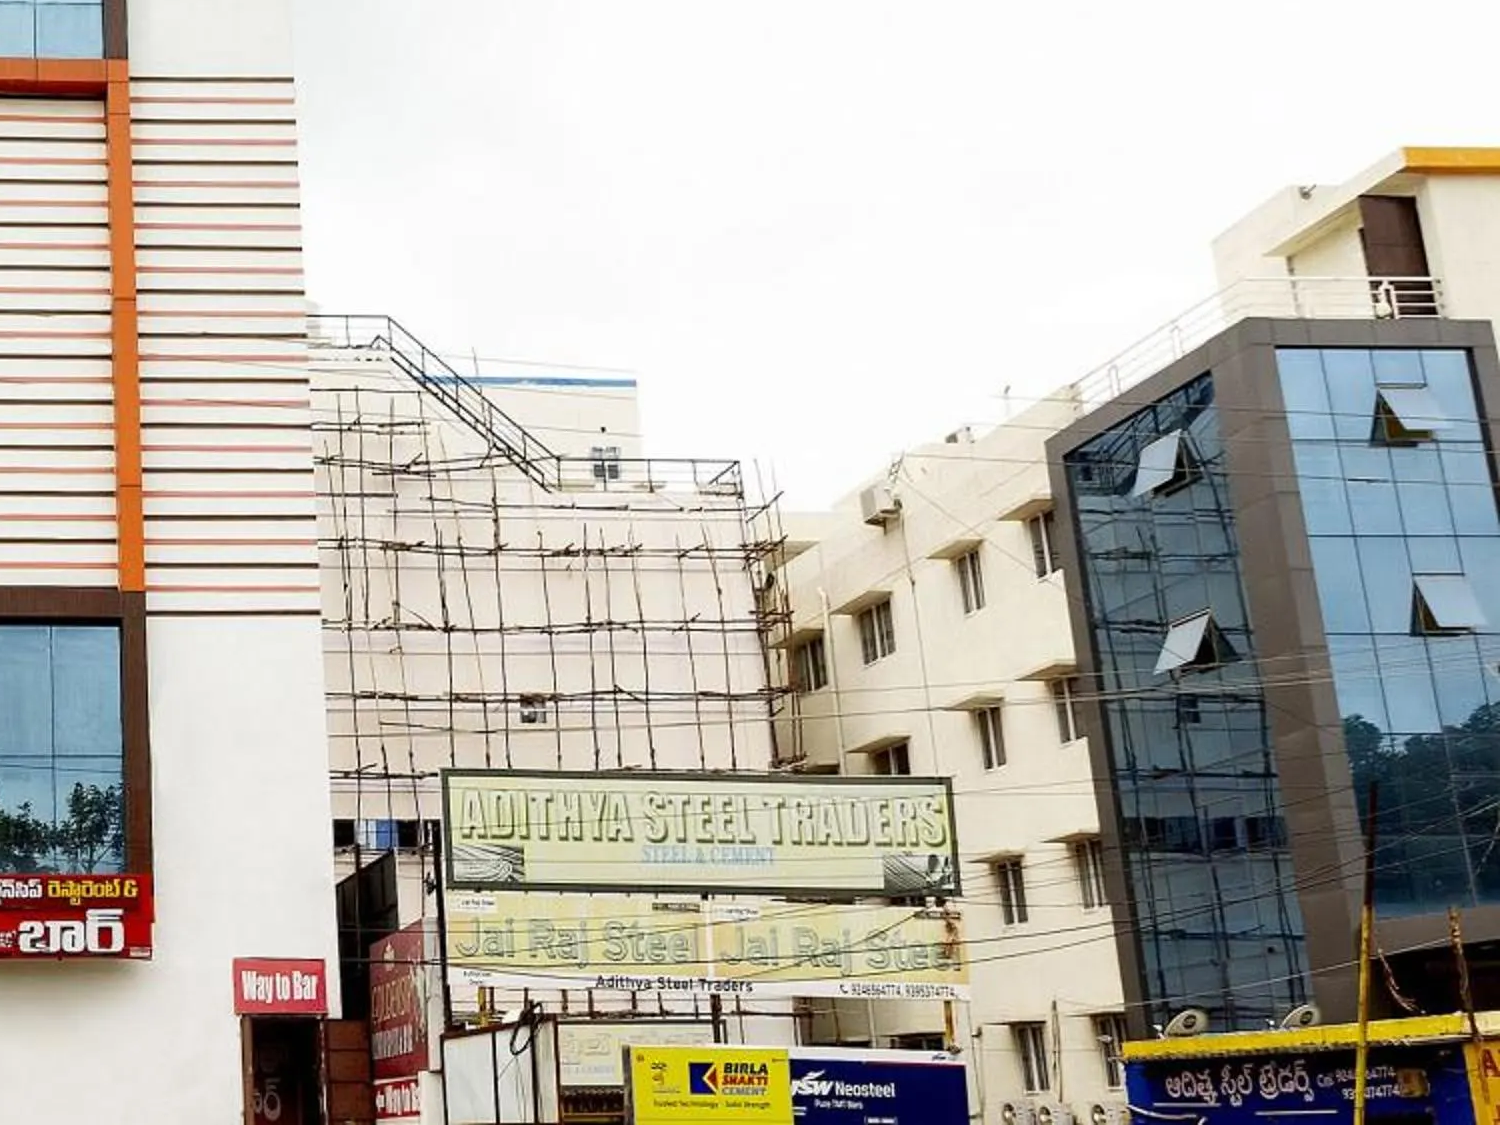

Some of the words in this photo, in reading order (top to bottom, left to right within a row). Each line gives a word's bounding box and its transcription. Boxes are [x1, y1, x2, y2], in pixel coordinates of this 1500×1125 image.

[461, 788, 635, 843] ADITHYA
[643, 791, 756, 845] STEEL
[762, 794, 947, 848] TRADERS
[454, 917, 516, 958] Jai
[527, 918, 588, 970] Raj
[602, 920, 700, 963] Steel
[719, 926, 779, 967] Jai
[791, 926, 854, 977] Raj
[241, 970, 273, 1003] Way
[275, 972, 290, 1000] to
[292, 970, 318, 1000] Bar
[595, 975, 652, 992] Adithya
[657, 976, 693, 990] Steel
[698, 978, 753, 992] Traders
[722, 1075, 768, 1086] SHAKTI
[723, 1062, 768, 1075] BIRLA
[835, 1081, 896, 1098] Neosteel
